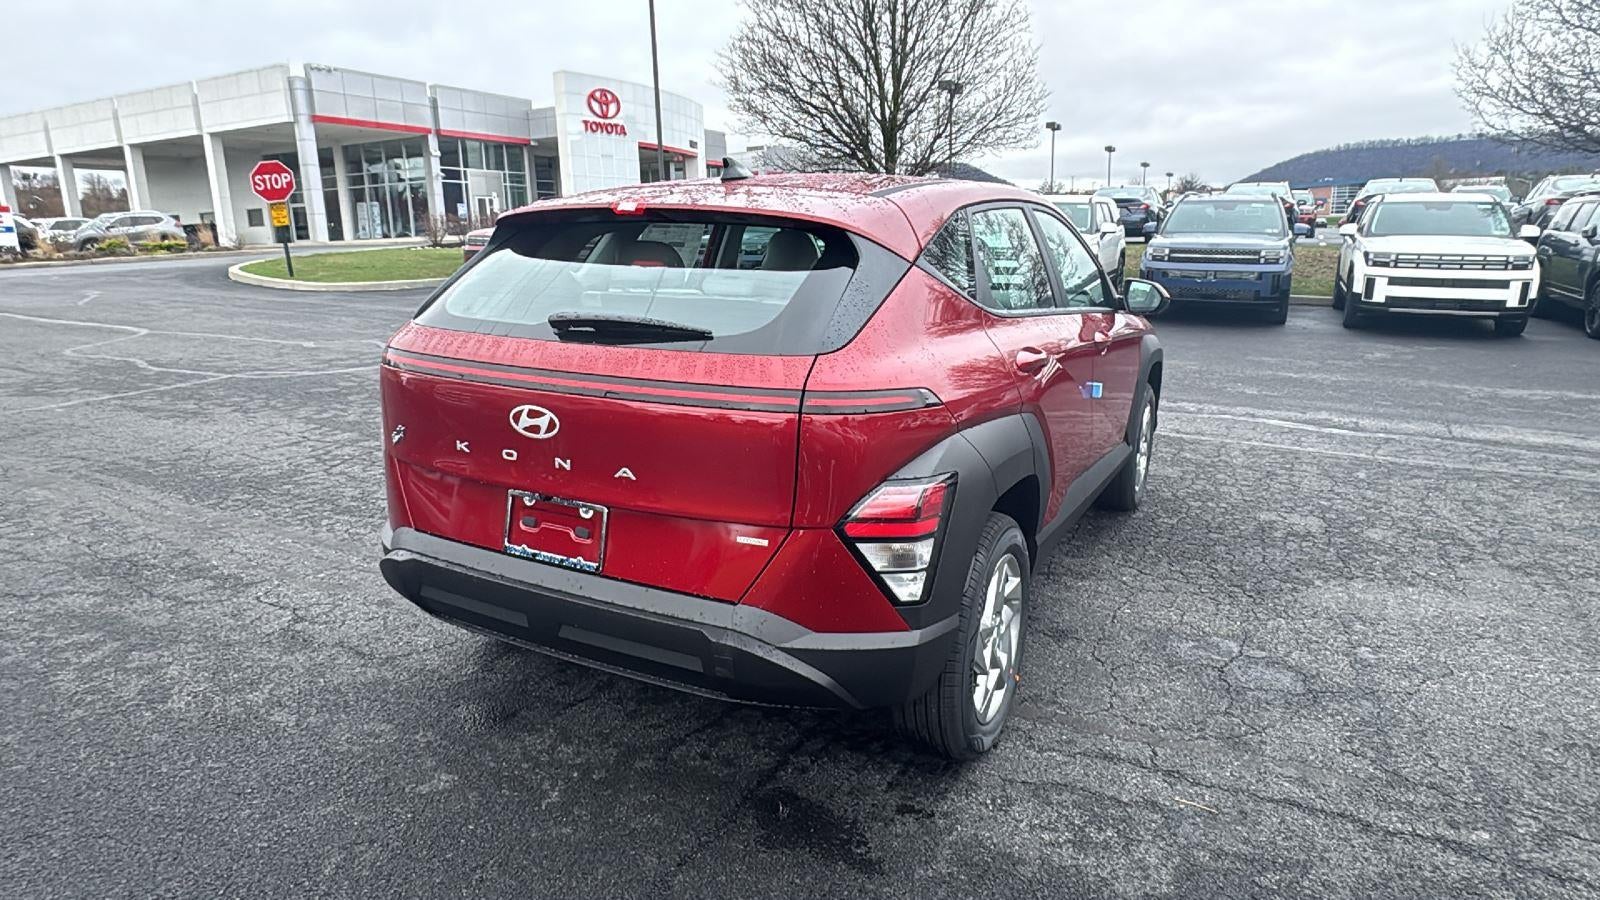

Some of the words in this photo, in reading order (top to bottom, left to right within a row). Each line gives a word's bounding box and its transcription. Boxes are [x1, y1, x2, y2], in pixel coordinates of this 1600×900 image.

[582, 120, 627, 136] TOYOTA
[254, 173, 291, 191] STOP
[456, 440, 636, 480] KONA
